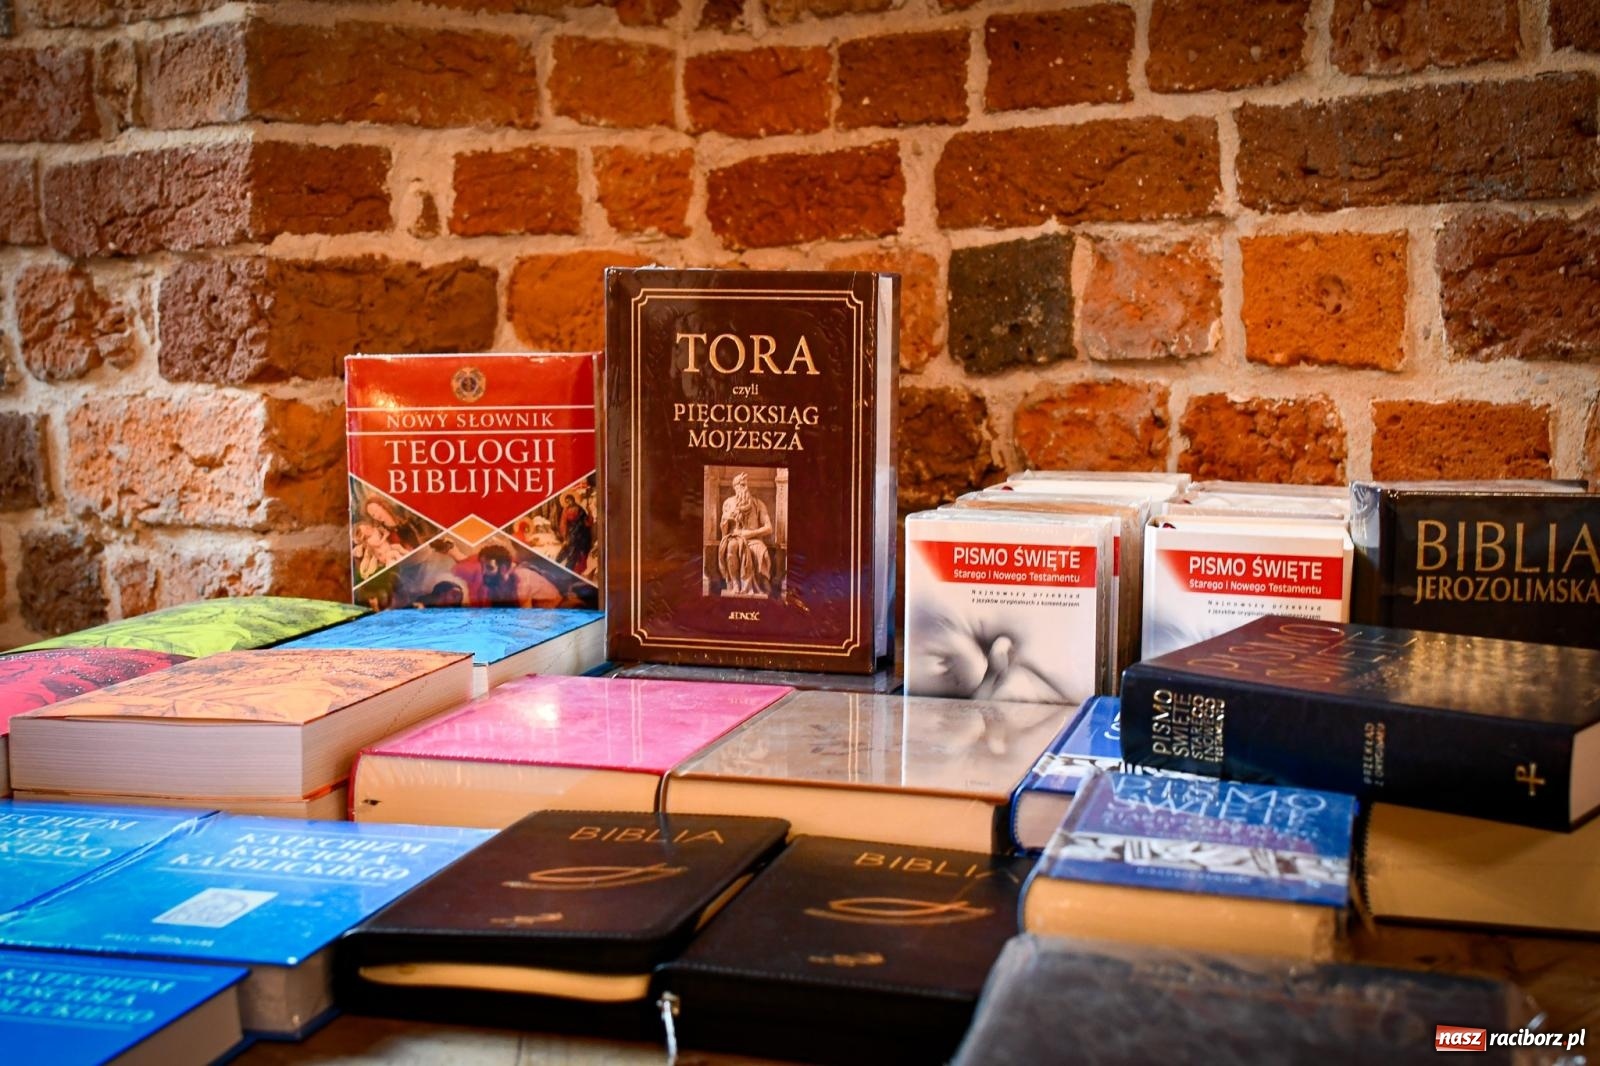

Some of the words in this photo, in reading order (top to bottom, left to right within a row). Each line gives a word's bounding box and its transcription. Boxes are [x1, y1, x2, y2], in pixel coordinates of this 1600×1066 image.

[676, 332, 821, 375] TORA
[732, 383, 759, 398] czyli
[386, 413, 448, 429] NOWY
[456, 412, 554, 428] SŁOWNIK
[673, 403, 819, 430] PIĘCIOKSIĄG
[384, 438, 556, 465] TEOLOGII
[688, 427, 804, 452] MOJŻESZA
[388, 468, 556, 498] BIBLIJNEJ
[953, 546, 1008, 567] PISMO
[1013, 546, 1081, 571] ŚWIĘTE
[1416, 519, 1600, 574] BIBLIA
[953, 569, 986, 580] Starego
[993, 571, 1027, 582] Nowego
[1029, 572, 1080, 583] Testamentu
[1189, 556, 1246, 577] PISMO
[1252, 556, 1323, 582] ŚWIĘTE
[1189, 578, 1224, 591] Starego
[1230, 581, 1265, 593] Nowego
[1269, 582, 1322, 595] Testamentu
[1413, 575, 1600, 604] JEROZOLIMSKA
[1152, 689, 1173, 755] PISMO
[0, 813, 139, 830] ECHIZM
[569, 826, 725, 844] BIBLIA
